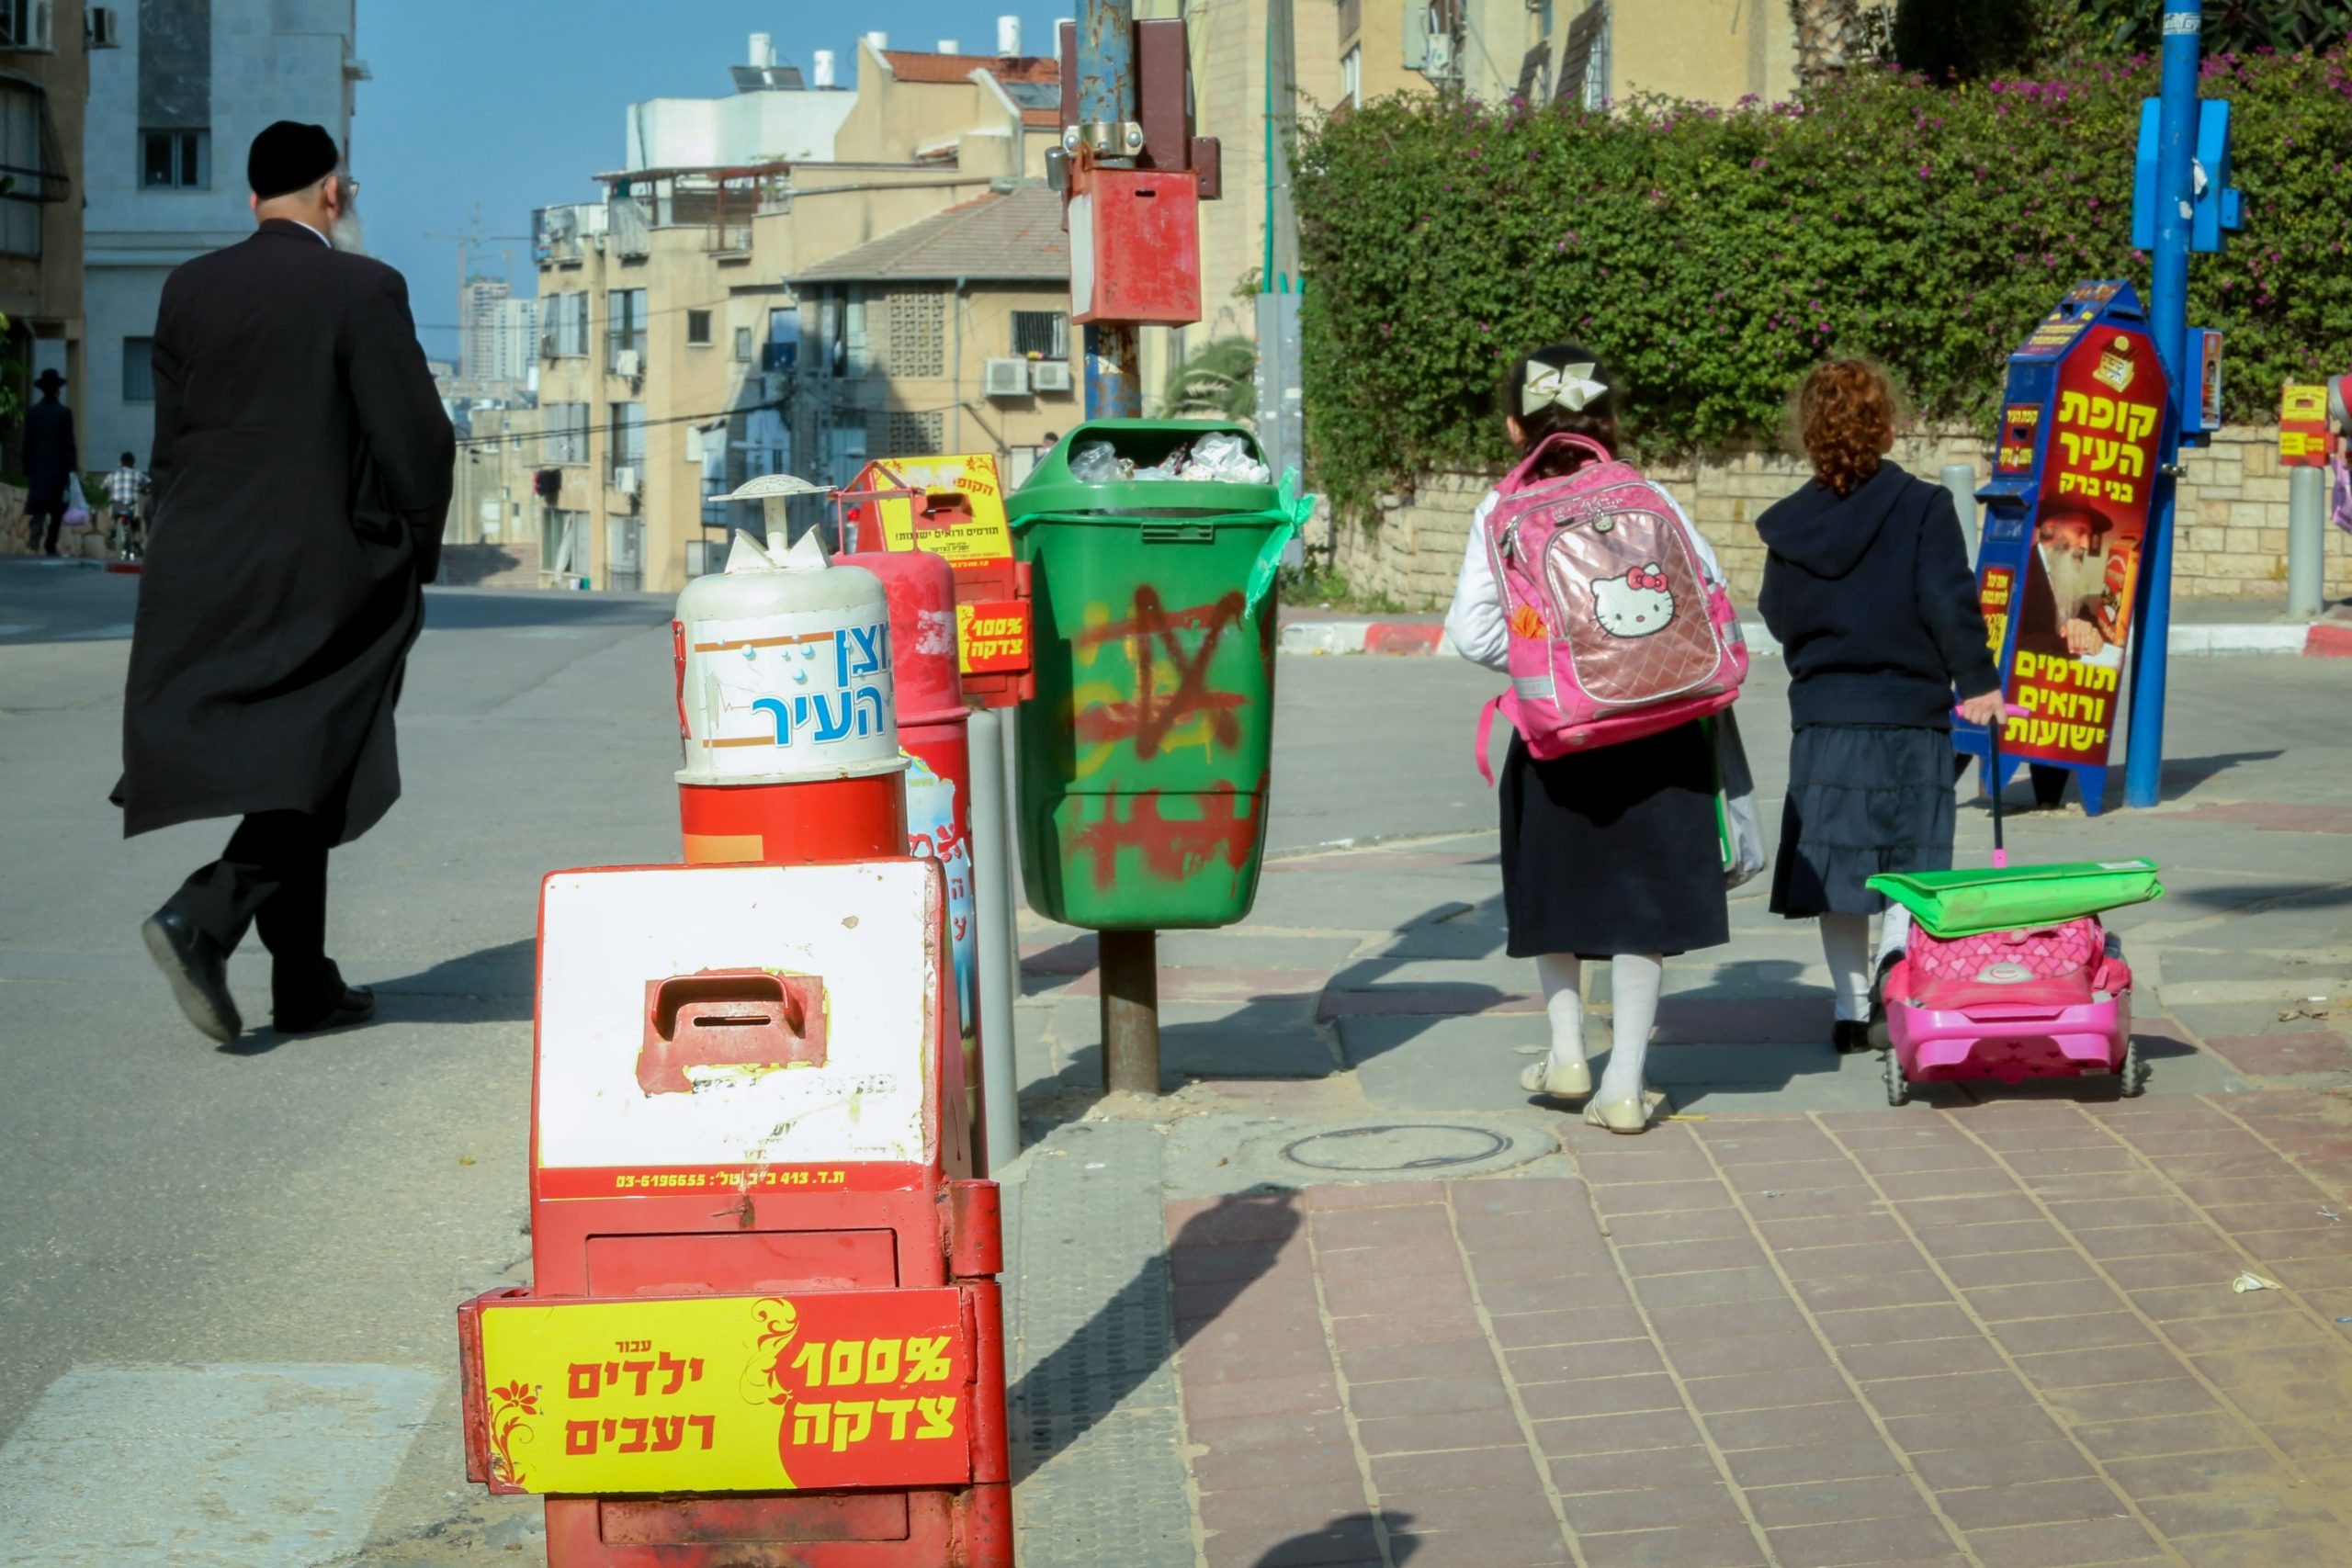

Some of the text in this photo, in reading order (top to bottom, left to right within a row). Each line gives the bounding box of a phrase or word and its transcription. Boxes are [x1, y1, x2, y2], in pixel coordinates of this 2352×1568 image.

[2059, 390, 2157, 443] קופת
[2060, 432, 2144, 478] העיר
[953, 477, 994, 497] הקופ
[2059, 472, 2133, 502] בני ברק
[967, 527, 999, 537] תורמים
[971, 617, 1023, 637] 100%
[971, 638, 1023, 660] צדקה
[2015, 650, 2118, 692] תורמים
[752, 685, 885, 747] העיר
[2018, 685, 2105, 723] ורואים
[2005, 716, 2105, 751] ישועות
[616, 1174, 706, 1188] 03-6196655
[780, 1172, 808, 1185] 413
[615, 1338, 653, 1353] עבור
[792, 1336, 954, 1387] 100%
[567, 1351, 706, 1399] ילדים
[564, 1414, 716, 1456] רעבים
[792, 1395, 957, 1452] צדקה
